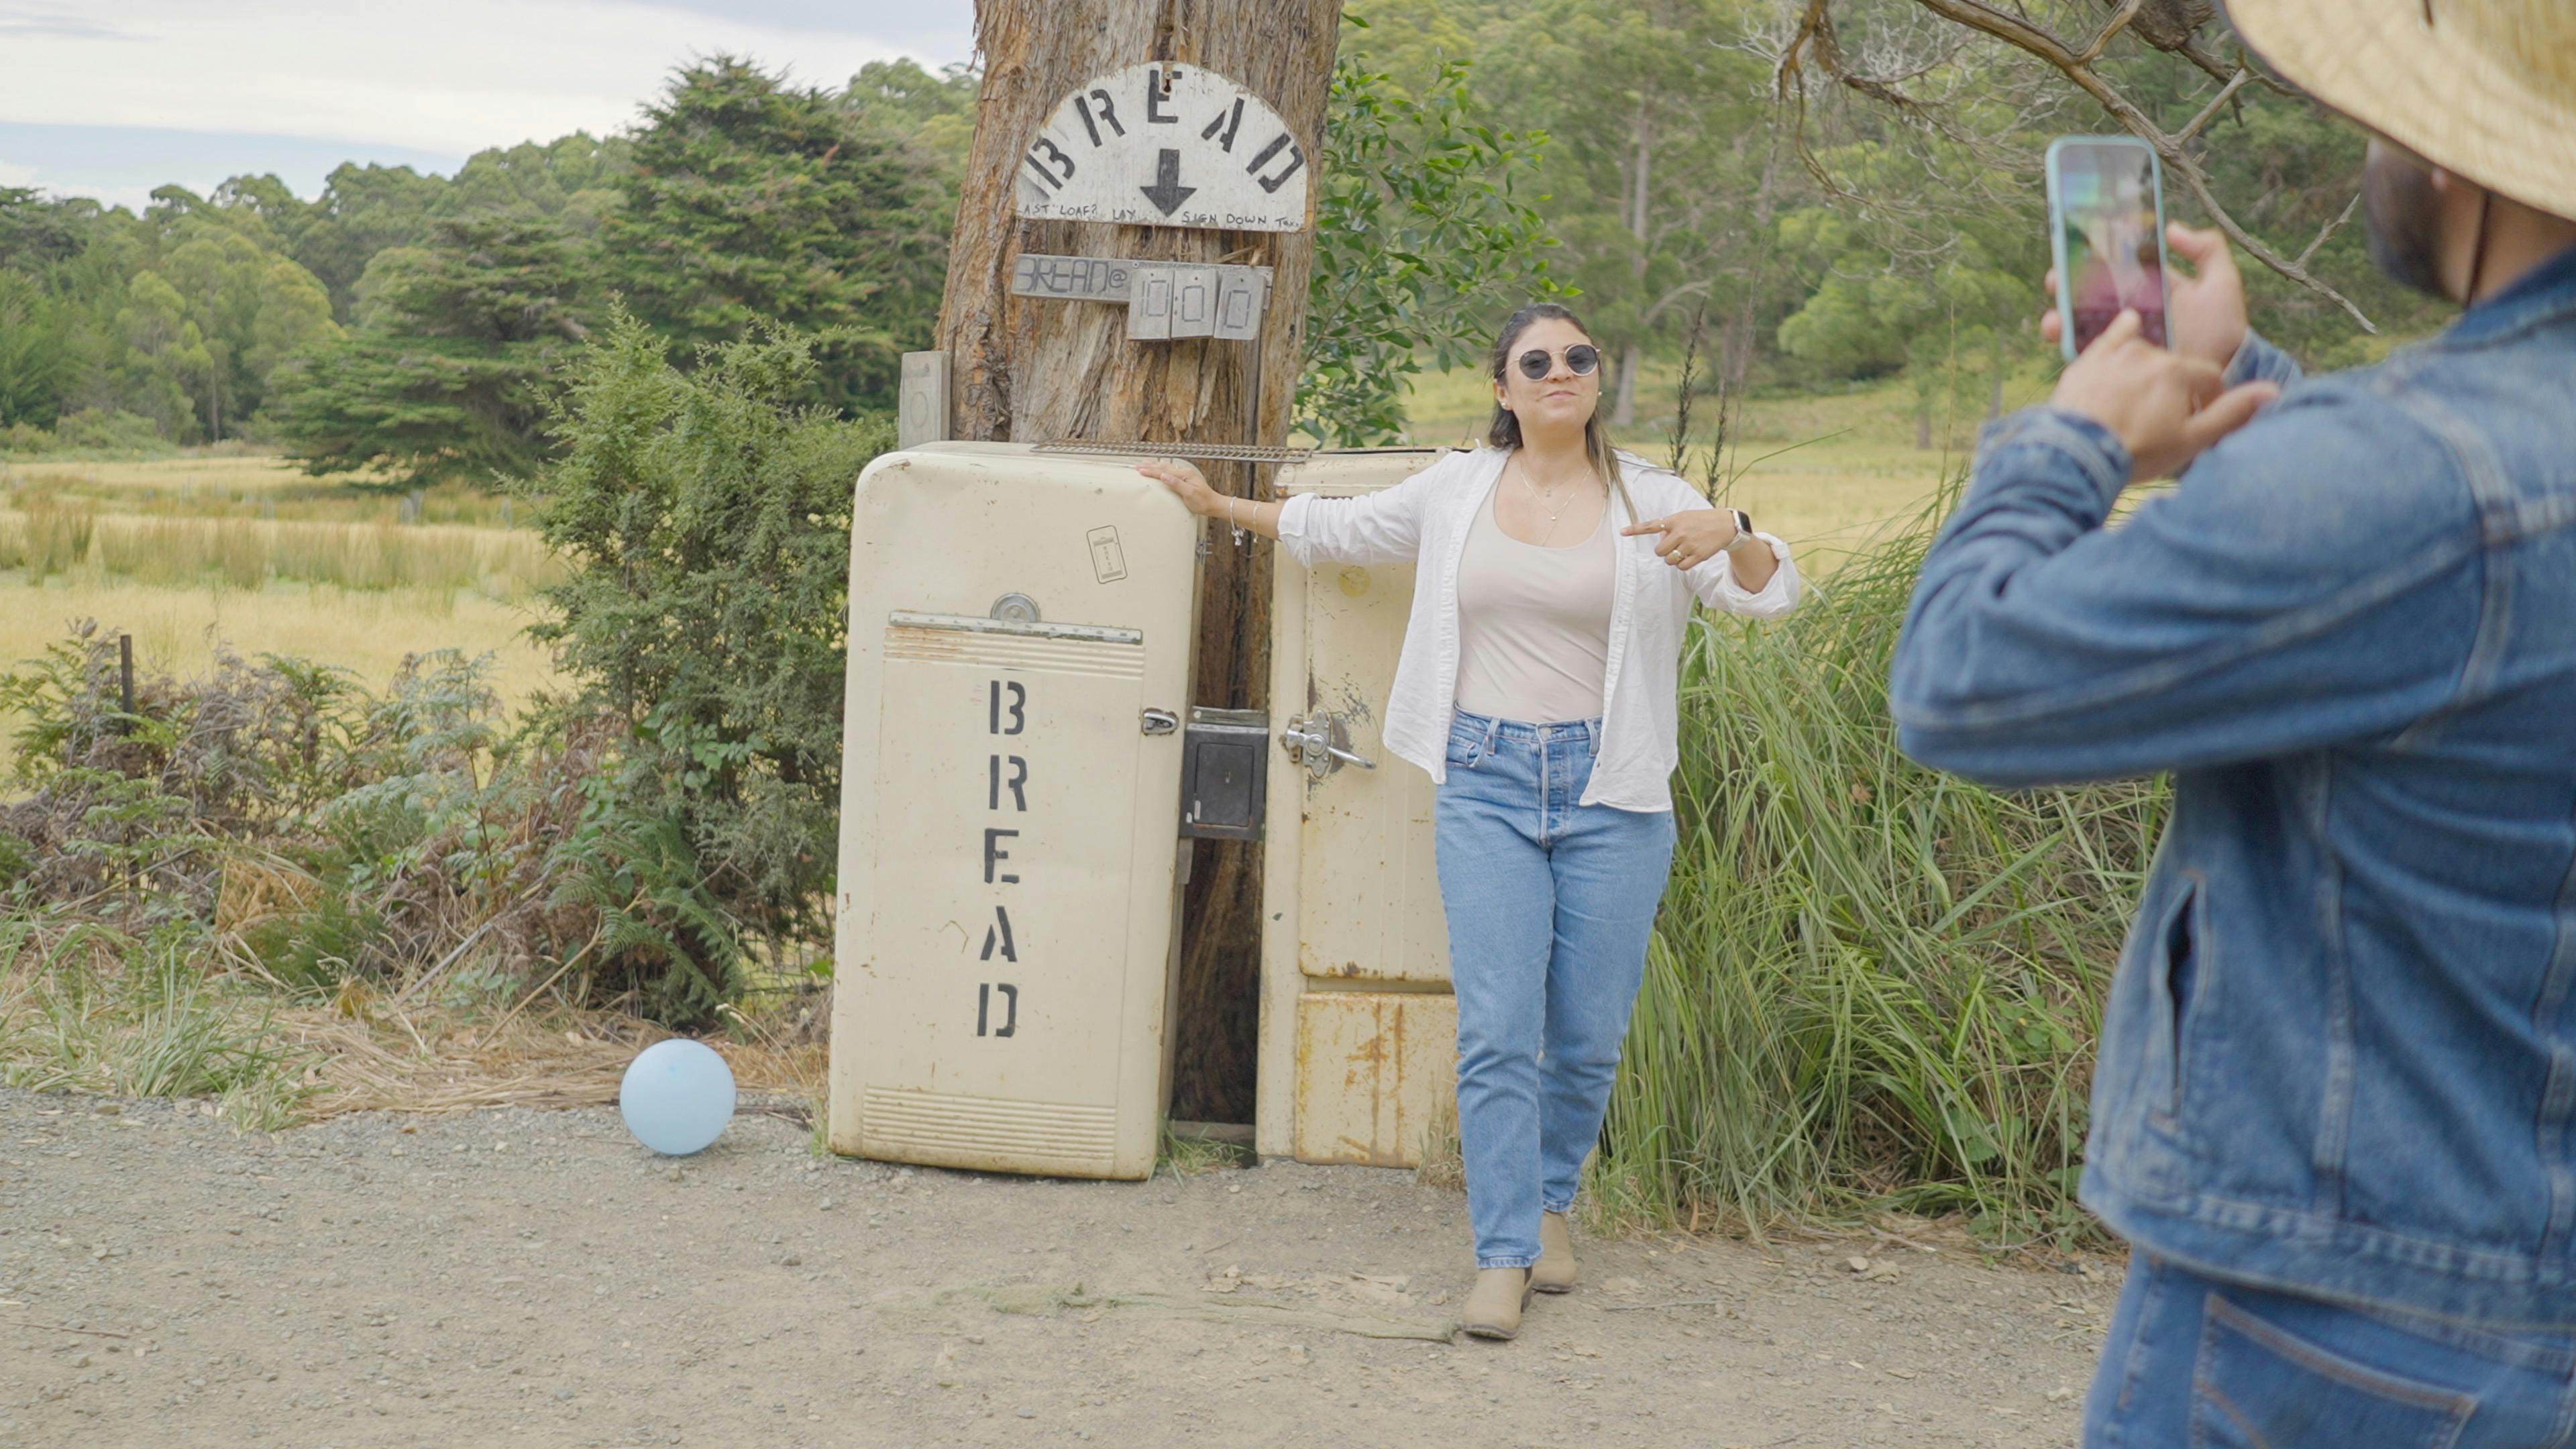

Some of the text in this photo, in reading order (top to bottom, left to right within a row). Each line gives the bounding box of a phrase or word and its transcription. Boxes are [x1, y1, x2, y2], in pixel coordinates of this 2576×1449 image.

[1024, 69, 1305, 194] BREAD
[1060, 204, 1097, 217] LOAF?
[1181, 211, 1217, 223] SIGN
[1226, 213, 1267, 225] DOWN
[977, 680, 1027, 1038] BREAD
